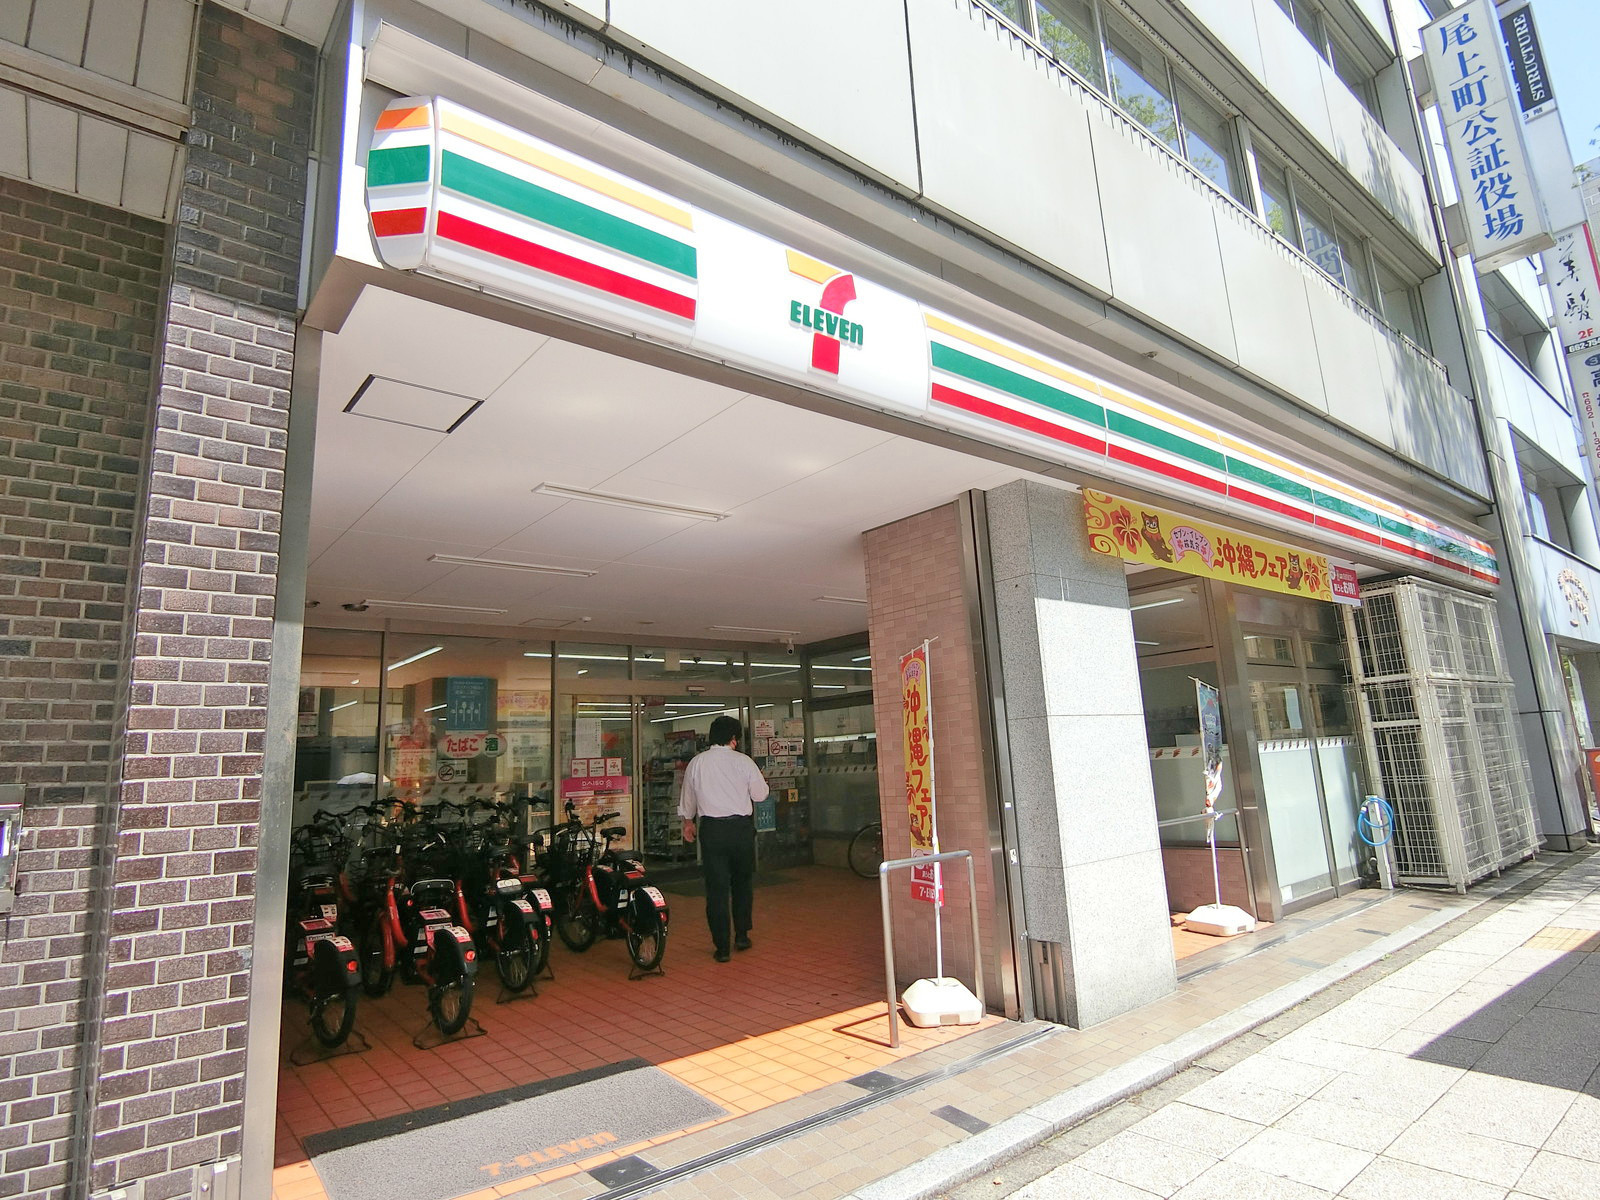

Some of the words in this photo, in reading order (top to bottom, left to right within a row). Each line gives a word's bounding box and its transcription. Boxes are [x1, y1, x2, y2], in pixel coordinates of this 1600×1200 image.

[1513, 13, 1546, 102] STRUCTURE
[1439, 12, 1525, 241] 尾上町公証役場
[1577, 327, 1594, 340] 2F
[1213, 536, 1288, 582] 沖縄フェア
[447, 738, 479, 752] たばこ
[485, 737, 499, 751] 酒
[905, 684, 932, 830] 沖縄フェア
